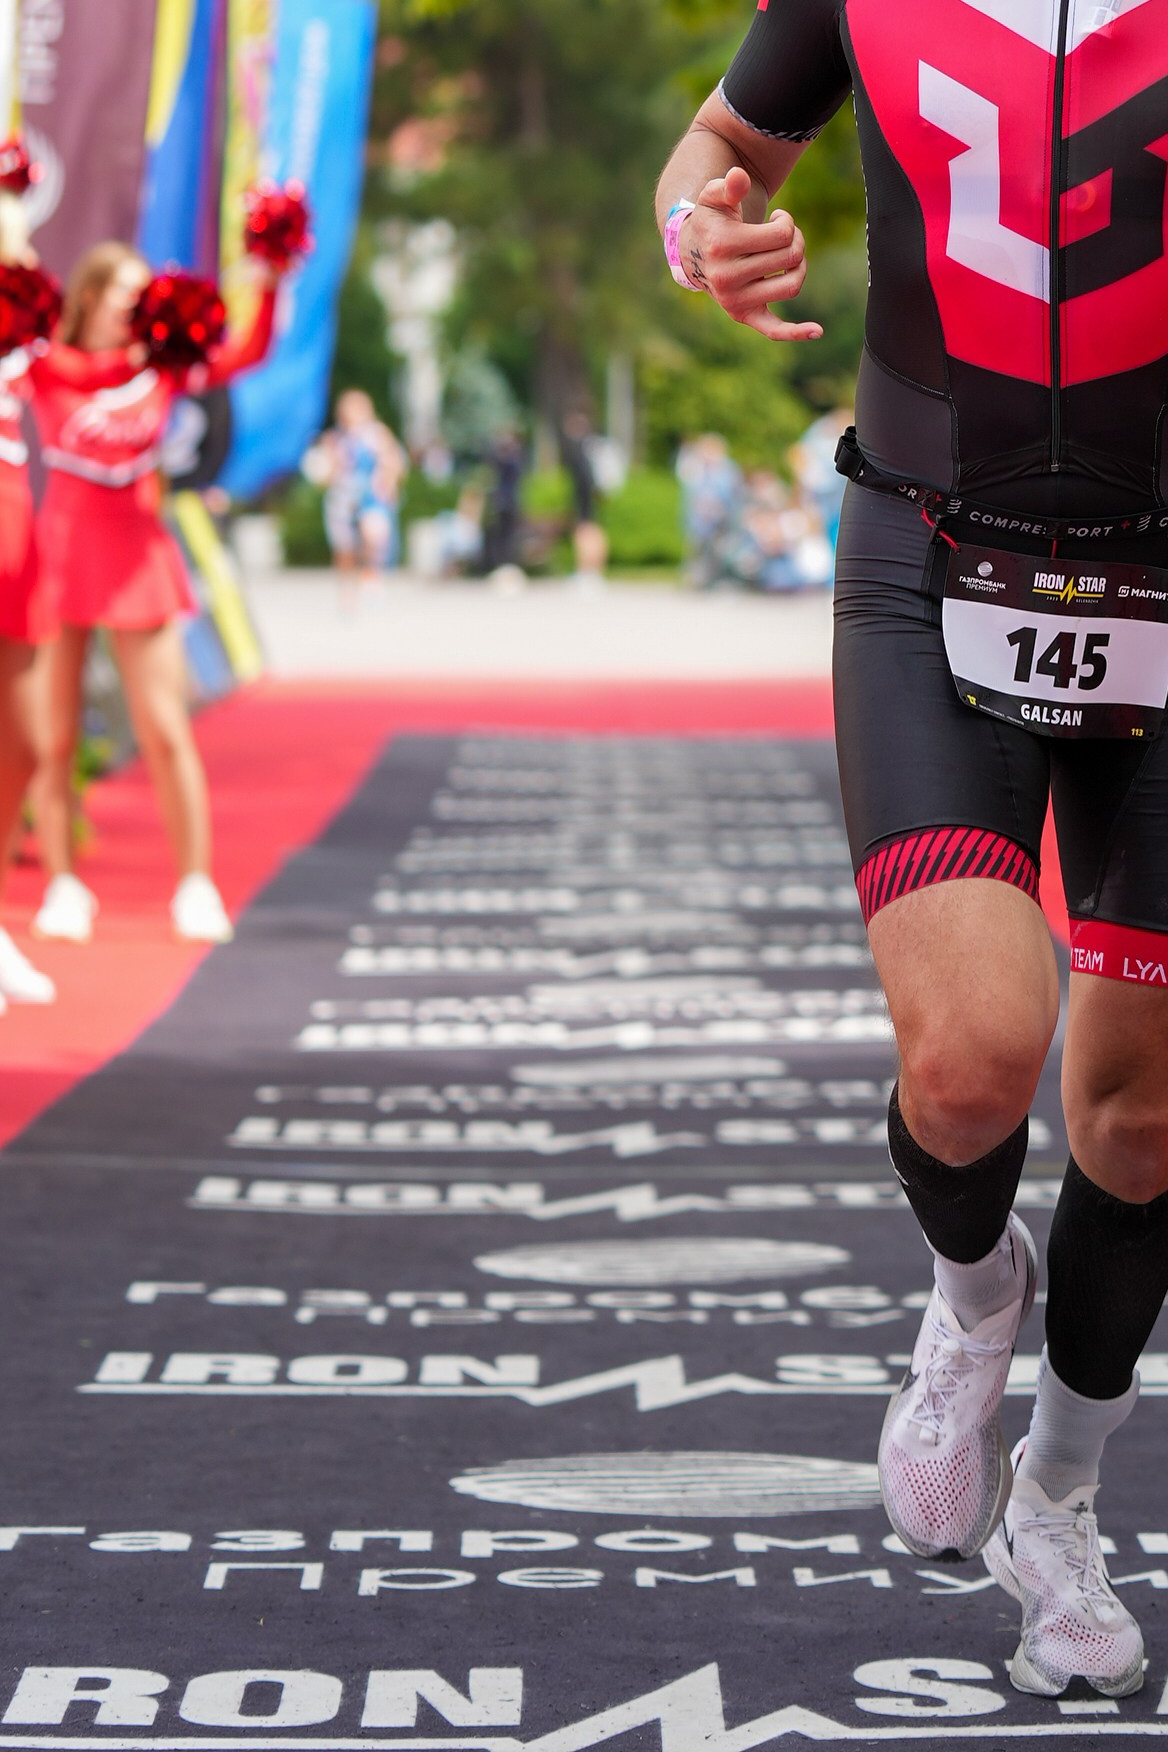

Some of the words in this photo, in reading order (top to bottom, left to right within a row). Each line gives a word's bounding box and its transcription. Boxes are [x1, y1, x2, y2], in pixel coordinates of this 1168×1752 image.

[958, 575, 1007, 590] ГАЗПРОМБАНК
[966, 582, 999, 594] ПРЕМИУМ
[1033, 572, 1065, 590] IRON
[1077, 576, 1107, 593] STAR
[1006, 626, 1111, 691] 145
[1020, 703, 1083, 726] GALSAN
[1131, 727, 1144, 737] 113
[1074, 948, 1104, 972] TEAM
[295, 1306, 908, 1329] Премиу
[96, 1351, 540, 1386] IRON
[2, 1665, 523, 1728] RON
